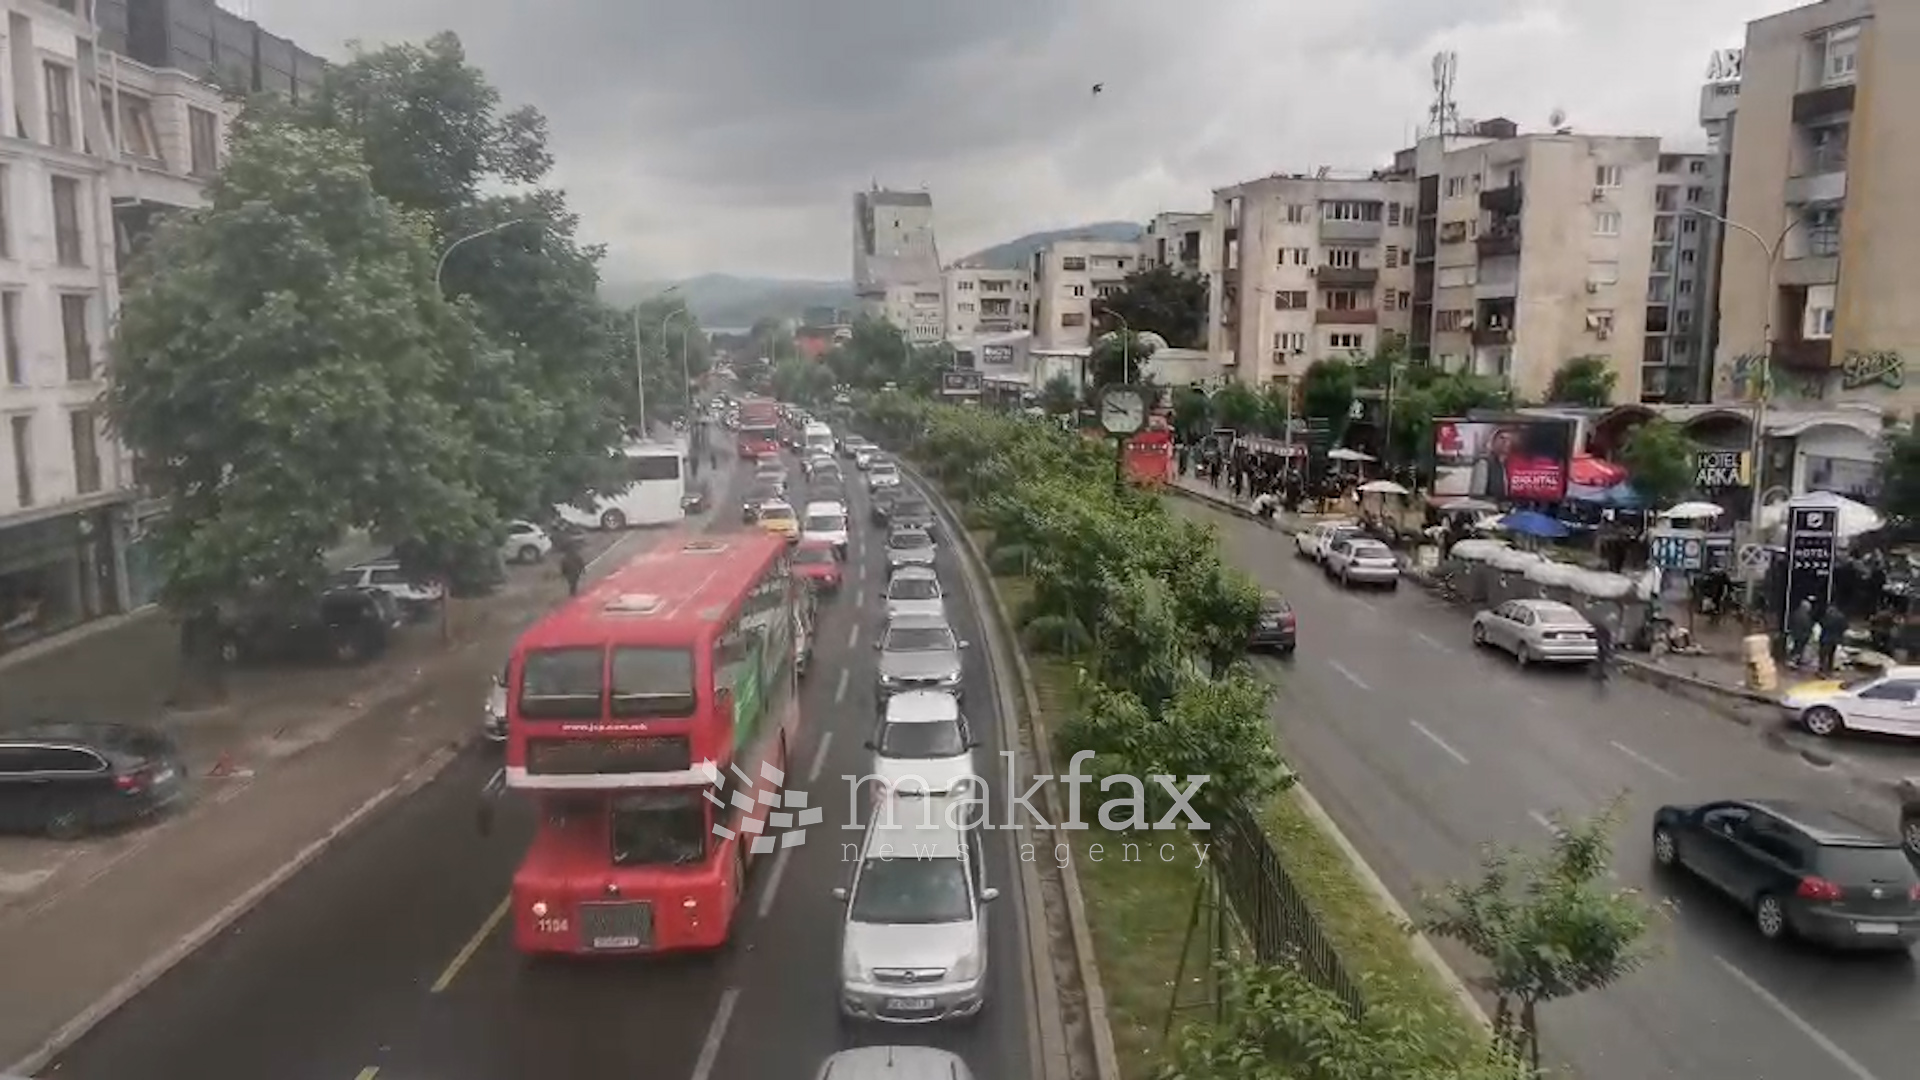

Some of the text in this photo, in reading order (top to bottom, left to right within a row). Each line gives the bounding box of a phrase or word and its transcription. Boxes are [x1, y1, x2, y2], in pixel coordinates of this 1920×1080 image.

[1706, 49, 1741, 80] AR
[1698, 453, 1739, 468] HOTEL
[1696, 468, 1740, 486] ARKA
